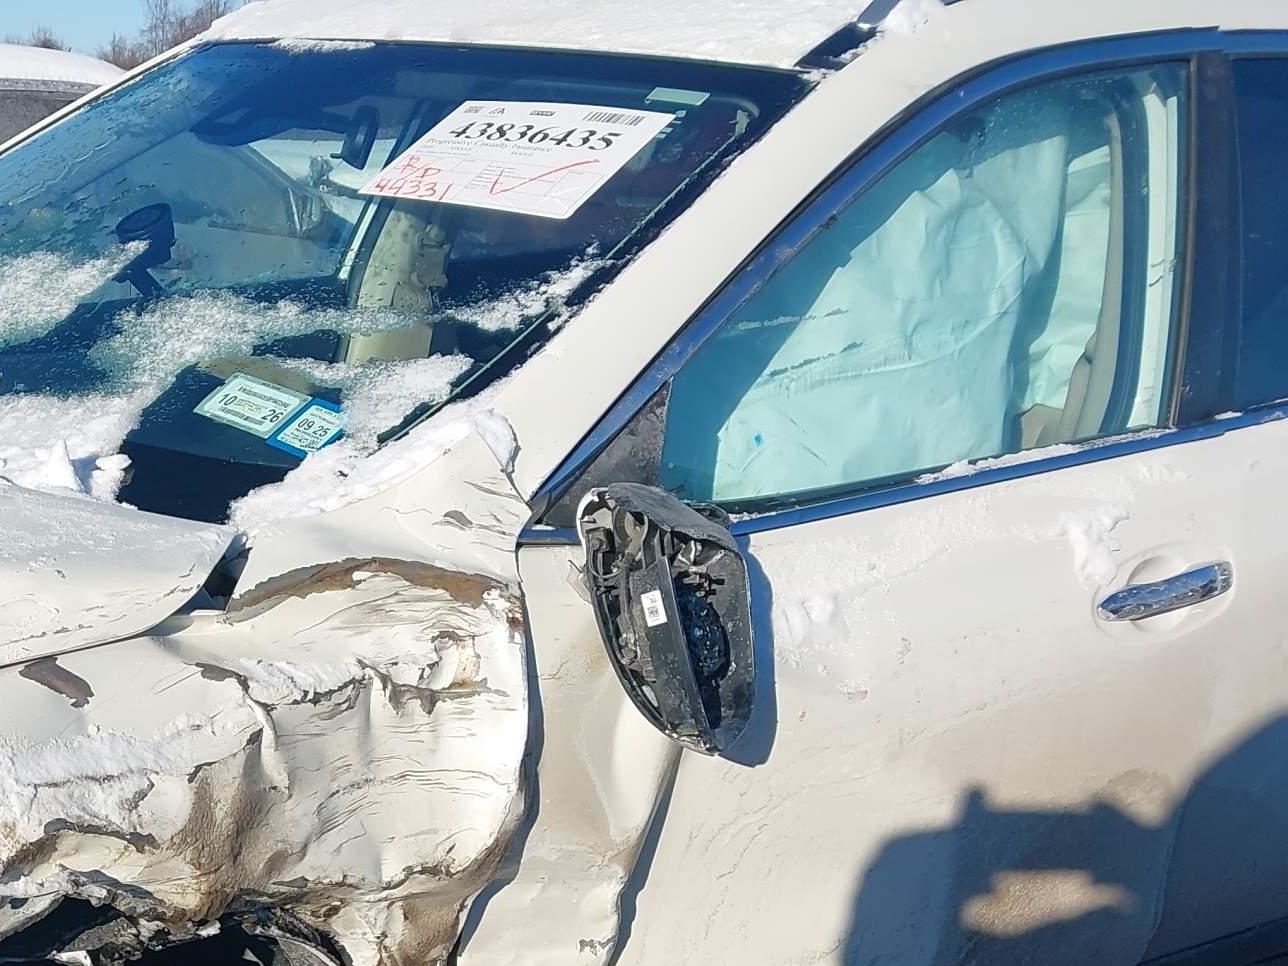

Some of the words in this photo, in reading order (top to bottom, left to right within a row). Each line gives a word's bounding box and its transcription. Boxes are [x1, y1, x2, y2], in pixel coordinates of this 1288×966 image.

[449, 120, 622, 150] 43836435
[218, 392, 238, 407] 10
[261, 409, 284, 423] 26
[297, 418, 316, 431] 09
[312, 425, 331, 437] 25
